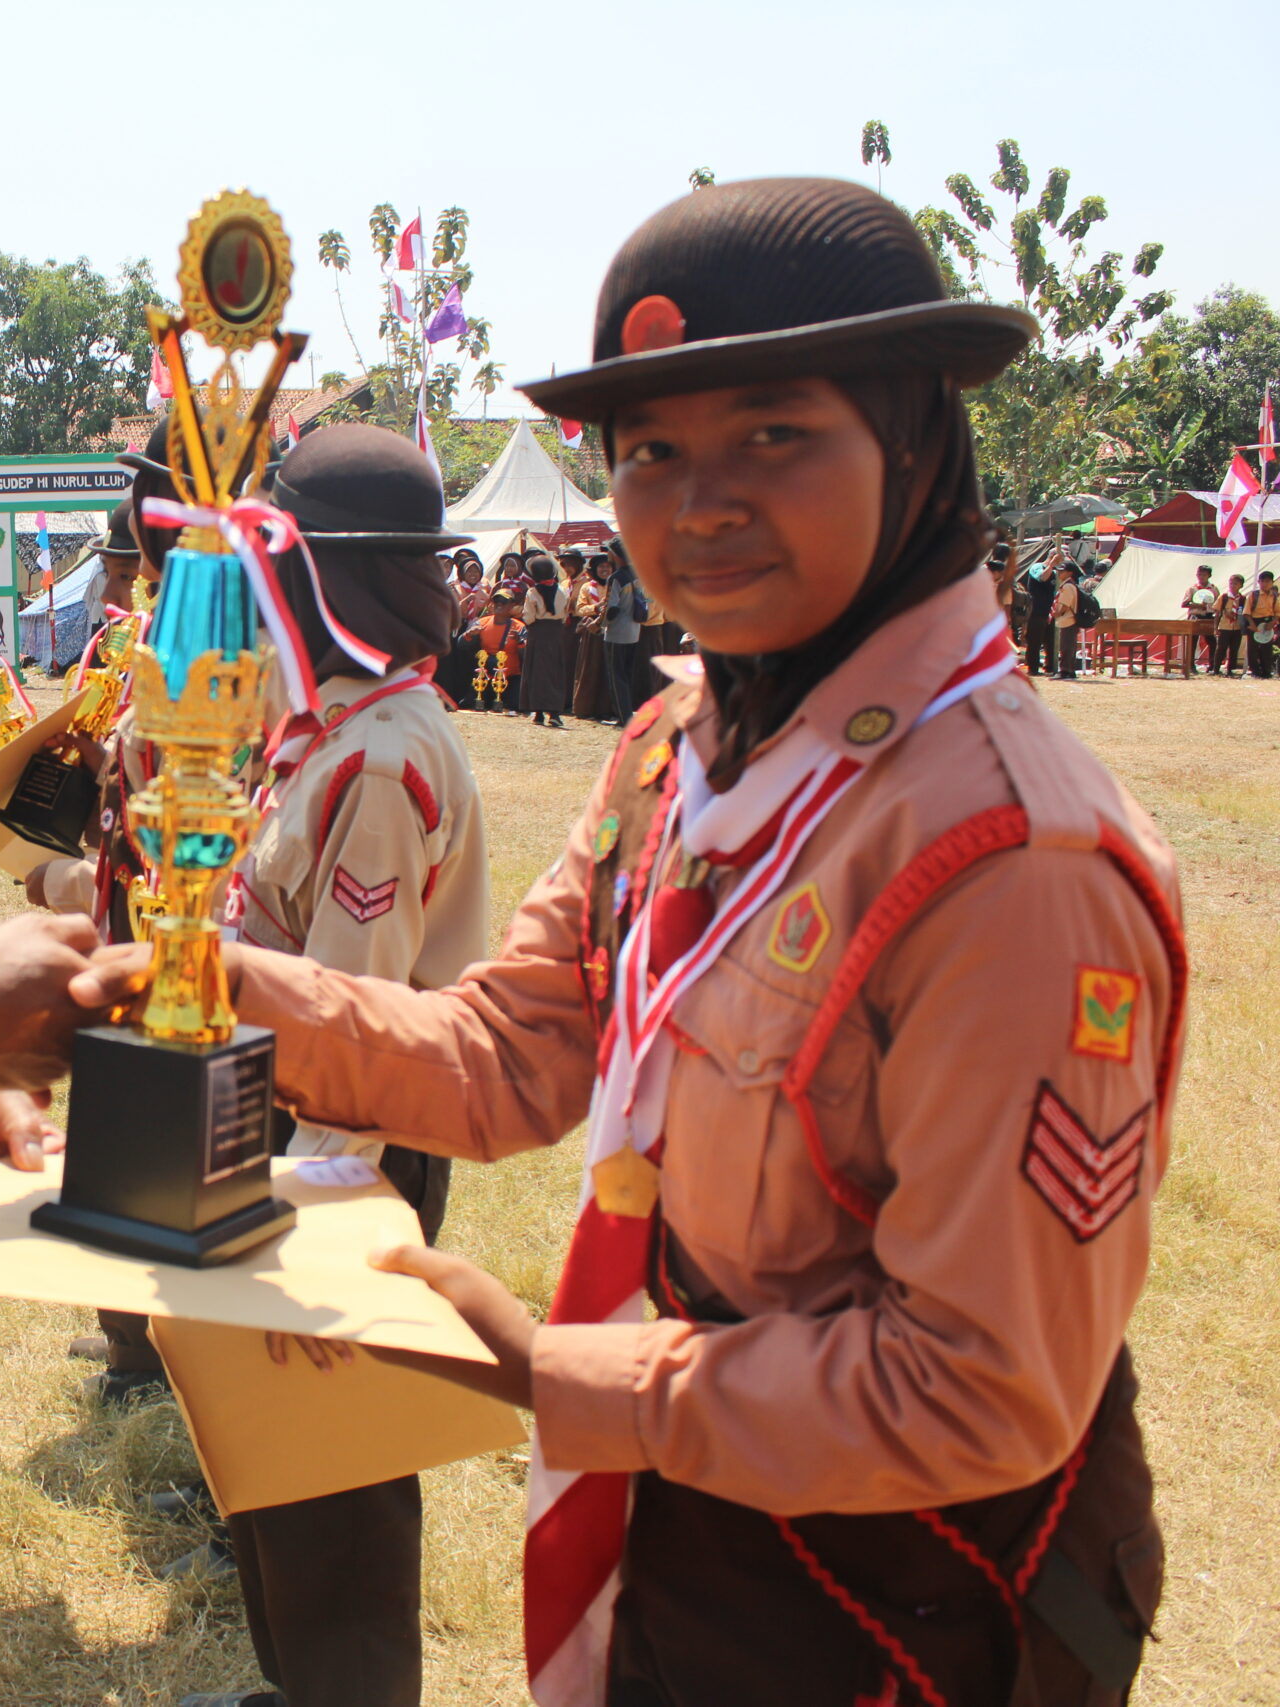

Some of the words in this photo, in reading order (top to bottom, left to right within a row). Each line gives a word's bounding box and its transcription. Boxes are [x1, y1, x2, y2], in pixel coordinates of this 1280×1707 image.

[37, 476, 49, 489] MI
[53, 476, 93, 489] NURUL
[94, 475, 126, 488] ULUM
